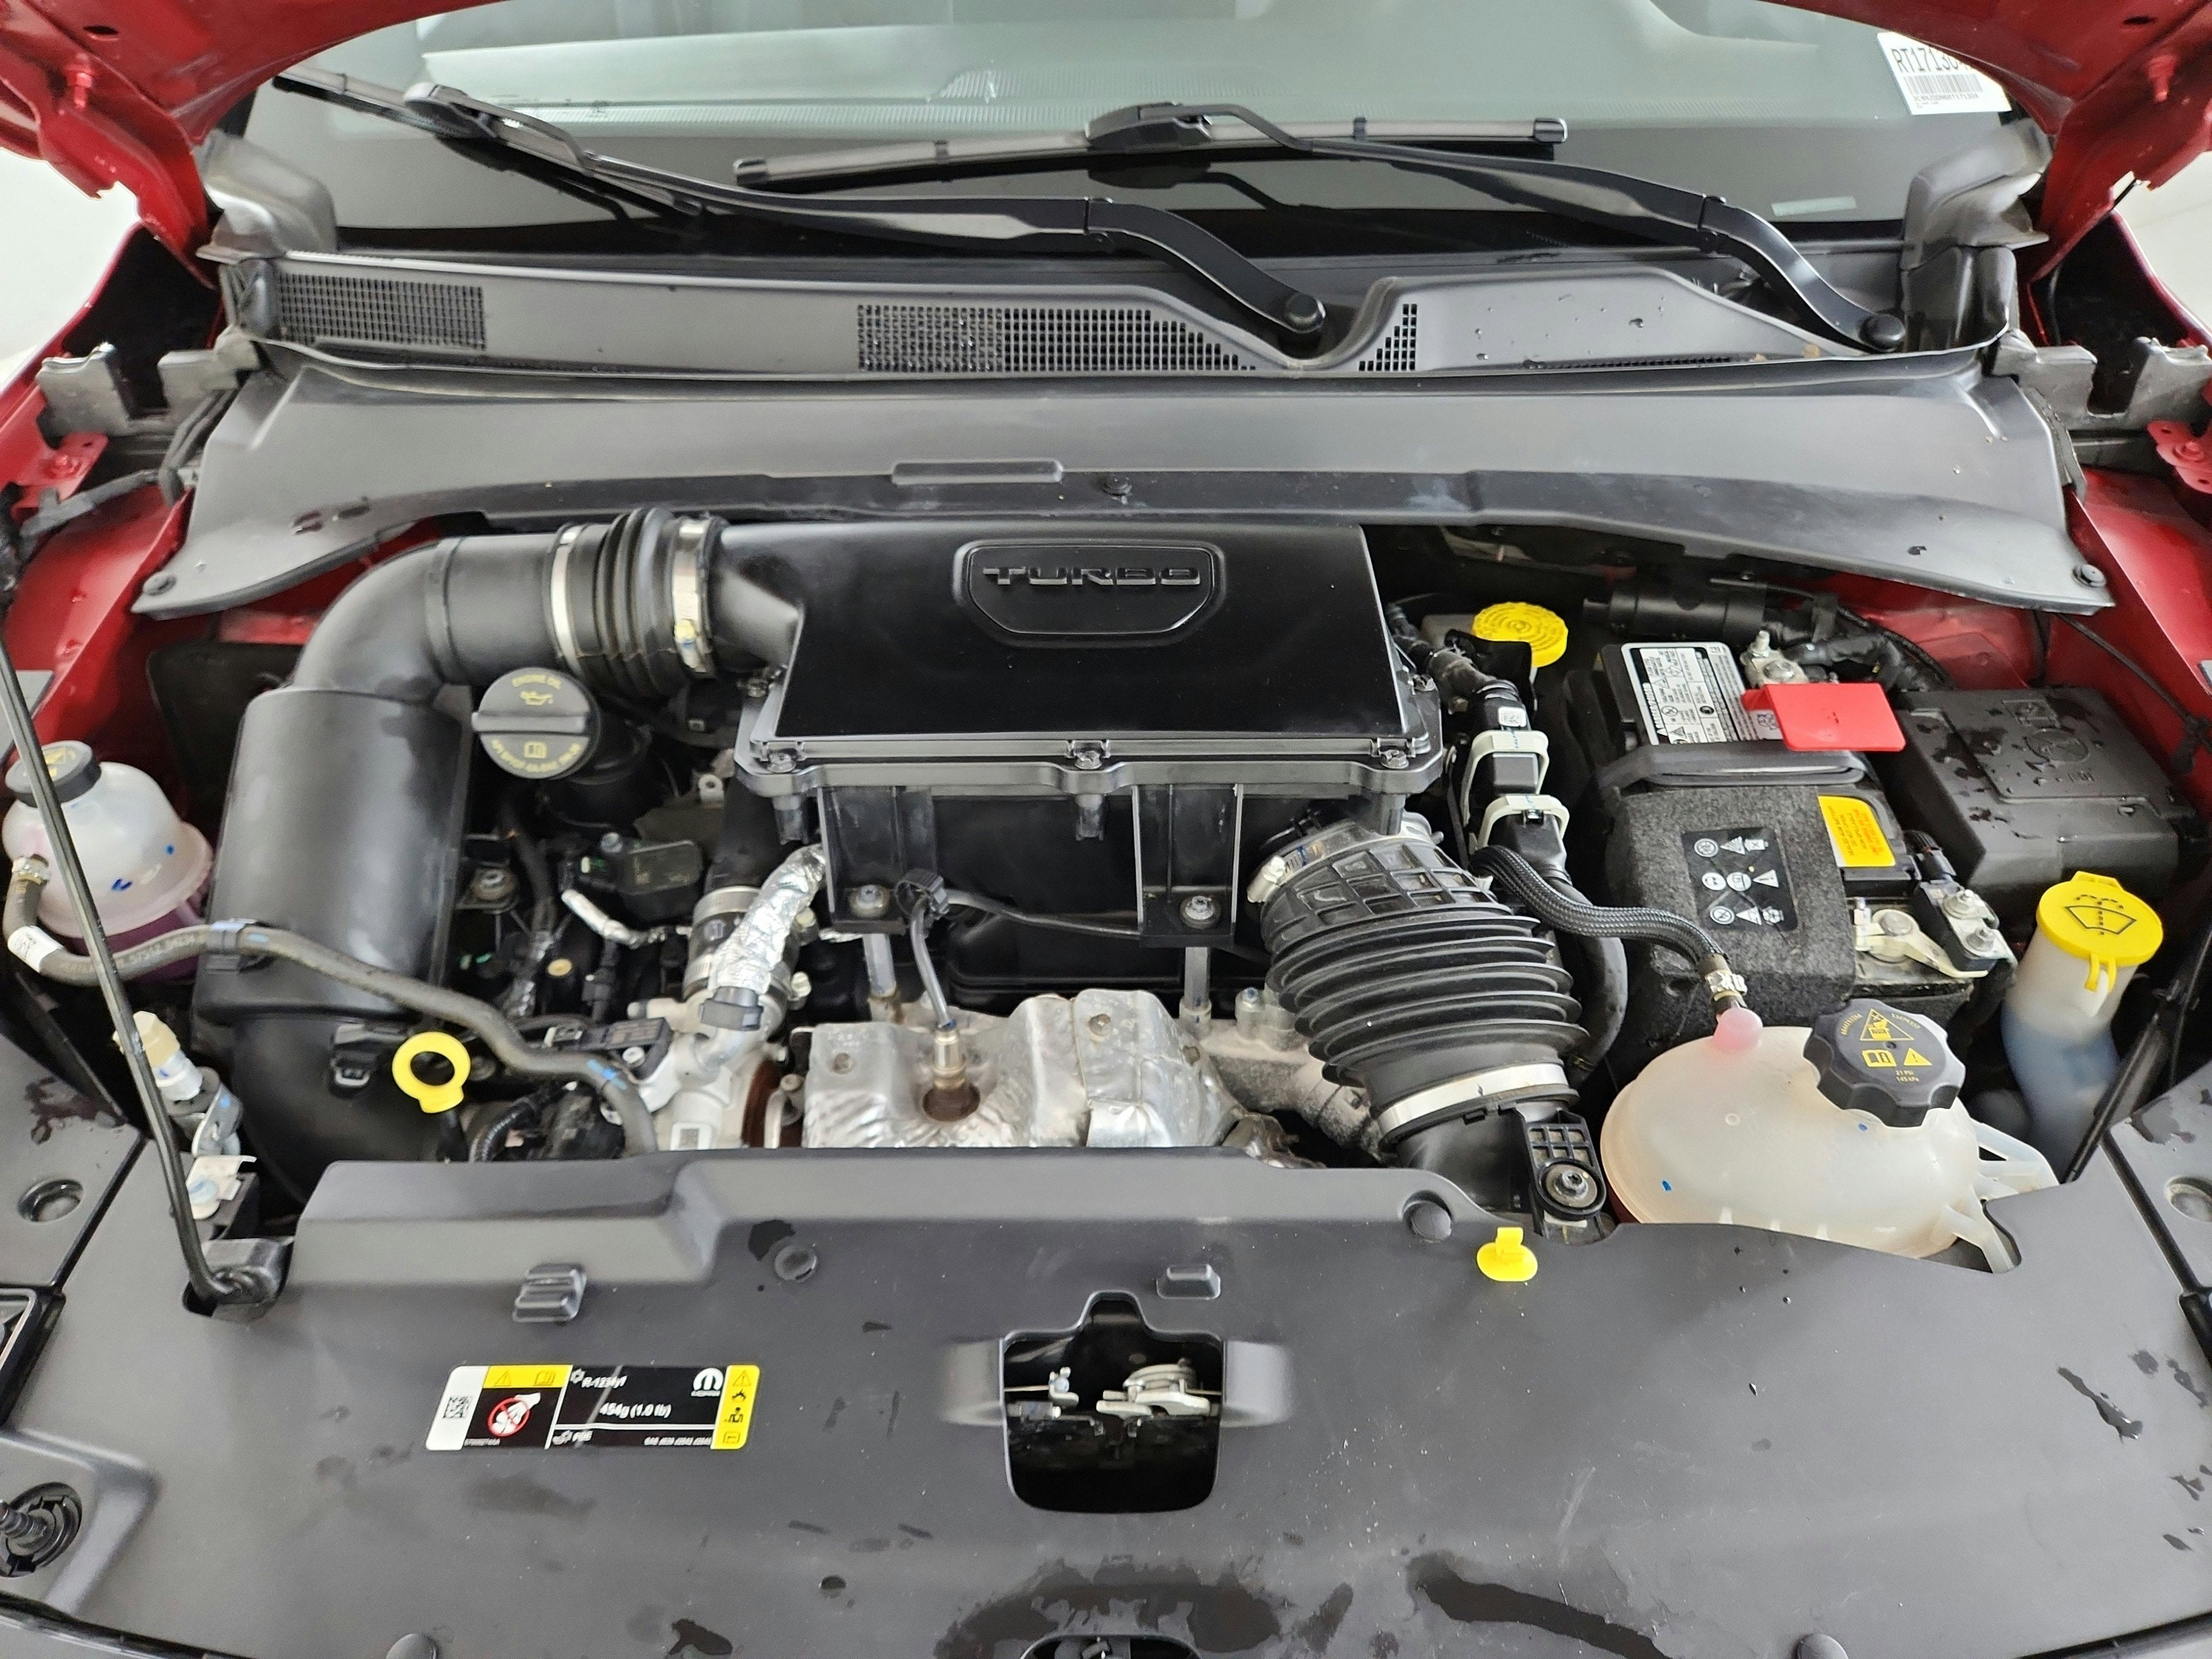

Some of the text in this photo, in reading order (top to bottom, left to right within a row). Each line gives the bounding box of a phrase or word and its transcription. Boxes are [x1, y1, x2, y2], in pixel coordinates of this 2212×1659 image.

[983, 566, 1200, 586] TURBO
[600, 1402, 631, 1419] 454g
[630, 1403, 654, 1419] (1.0
